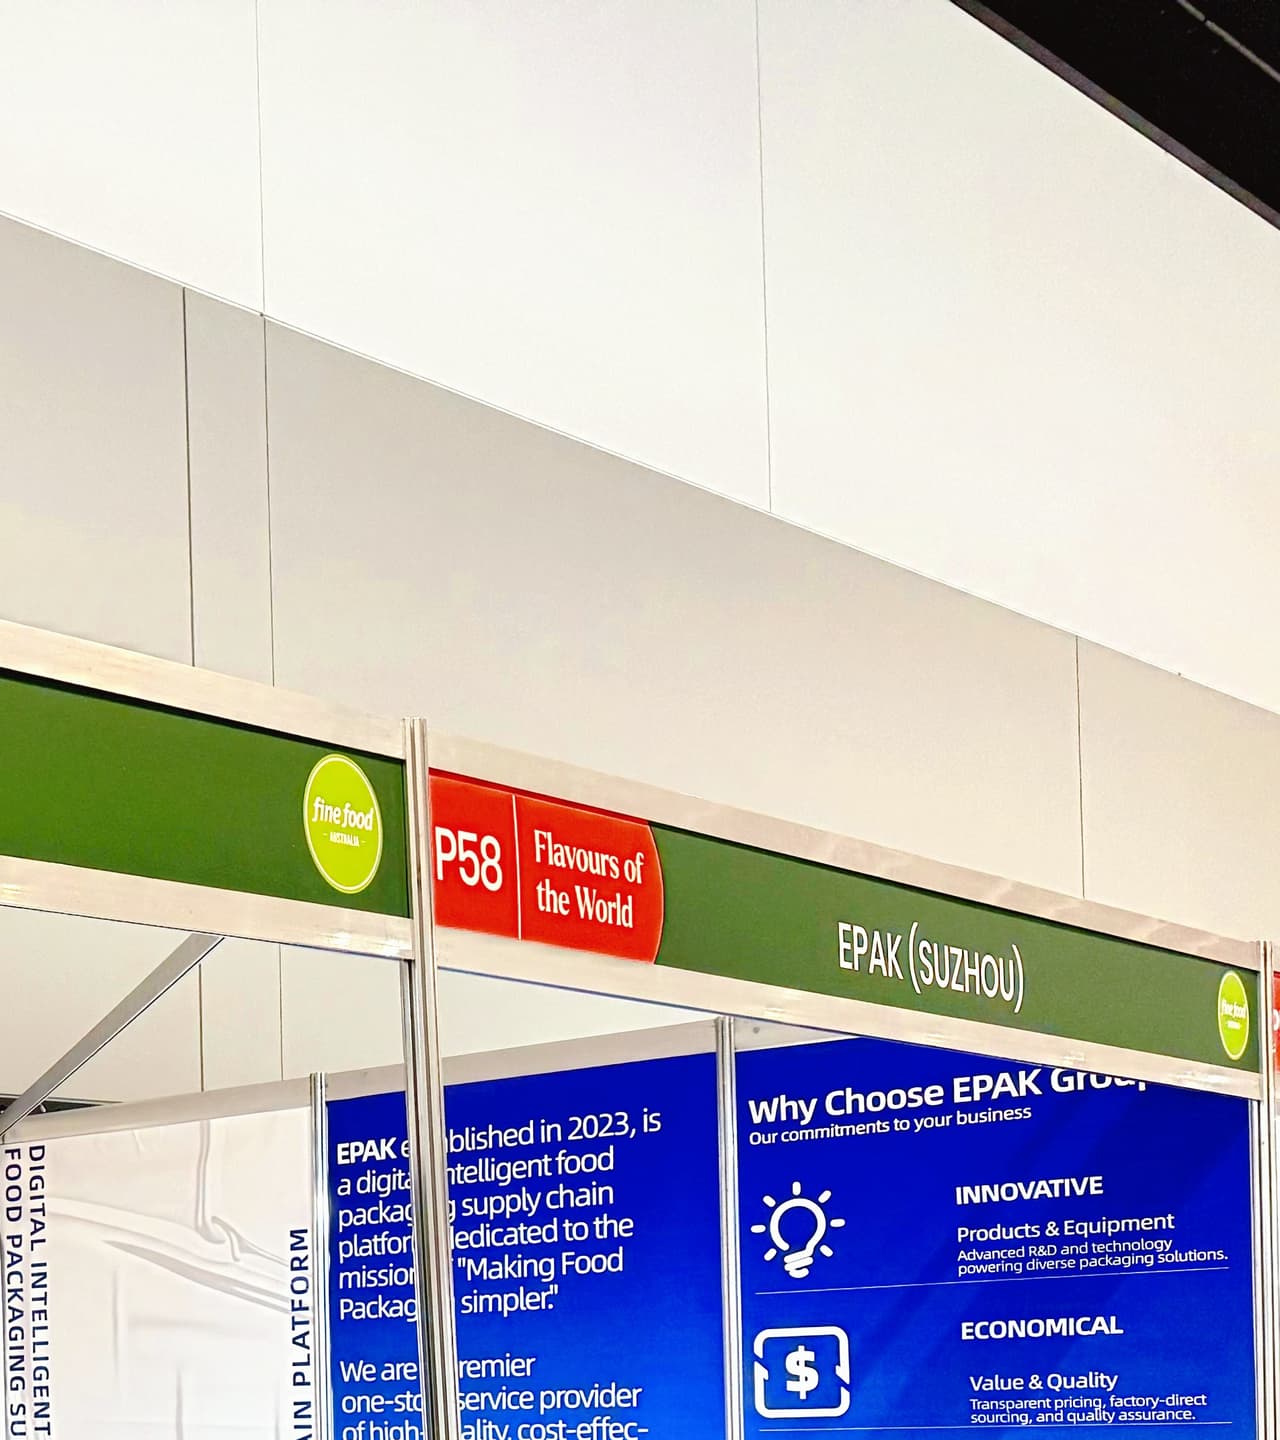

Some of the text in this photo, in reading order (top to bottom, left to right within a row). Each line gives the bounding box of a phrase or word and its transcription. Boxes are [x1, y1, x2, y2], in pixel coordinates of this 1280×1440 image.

[313, 797, 373, 831] fine food
[435, 826, 502, 891] P58
[534, 829, 645, 884] Flavours of
[536, 879, 633, 928] the World
[837, 921, 1025, 1013] EPAK (SUZHOU)
[748, 1068, 1042, 1125] Why Choose EPAK
[337, 1108, 661, 1165] EPAK in 2023, is
[749, 1104, 1032, 1146] Our commitments to your business
[556, 1146, 614, 1174] food
[5, 1149, 22, 1222] FOOD
[461, 1182, 614, 1220] supply chain
[955, 1176, 1104, 1205] INNOVATIVE
[563, 1214, 634, 1241] to the
[957, 1213, 1175, 1242] Products & Equipment
[457, 1247, 623, 1284] "Making Food
[957, 1238, 1173, 1261] Advanced R&D and technology
[958, 1248, 1229, 1277] powering diverse packaging solutions.
[28, 1146, 51, 1436] DIGITAL INTELLIGENT
[461, 1285, 558, 1317] simpler."
[6, 1235, 25, 1392] PACKAGING
[961, 1316, 1124, 1340] ECONOMICAL
[340, 1360, 417, 1382] We are
[970, 1372, 1118, 1392] Value & Quality
[457, 1382, 642, 1414] service provider
[970, 1394, 1207, 1413] Transparent pricing, factory-direct
[970, 1409, 1196, 1425] sourcing, and quality assurance.
